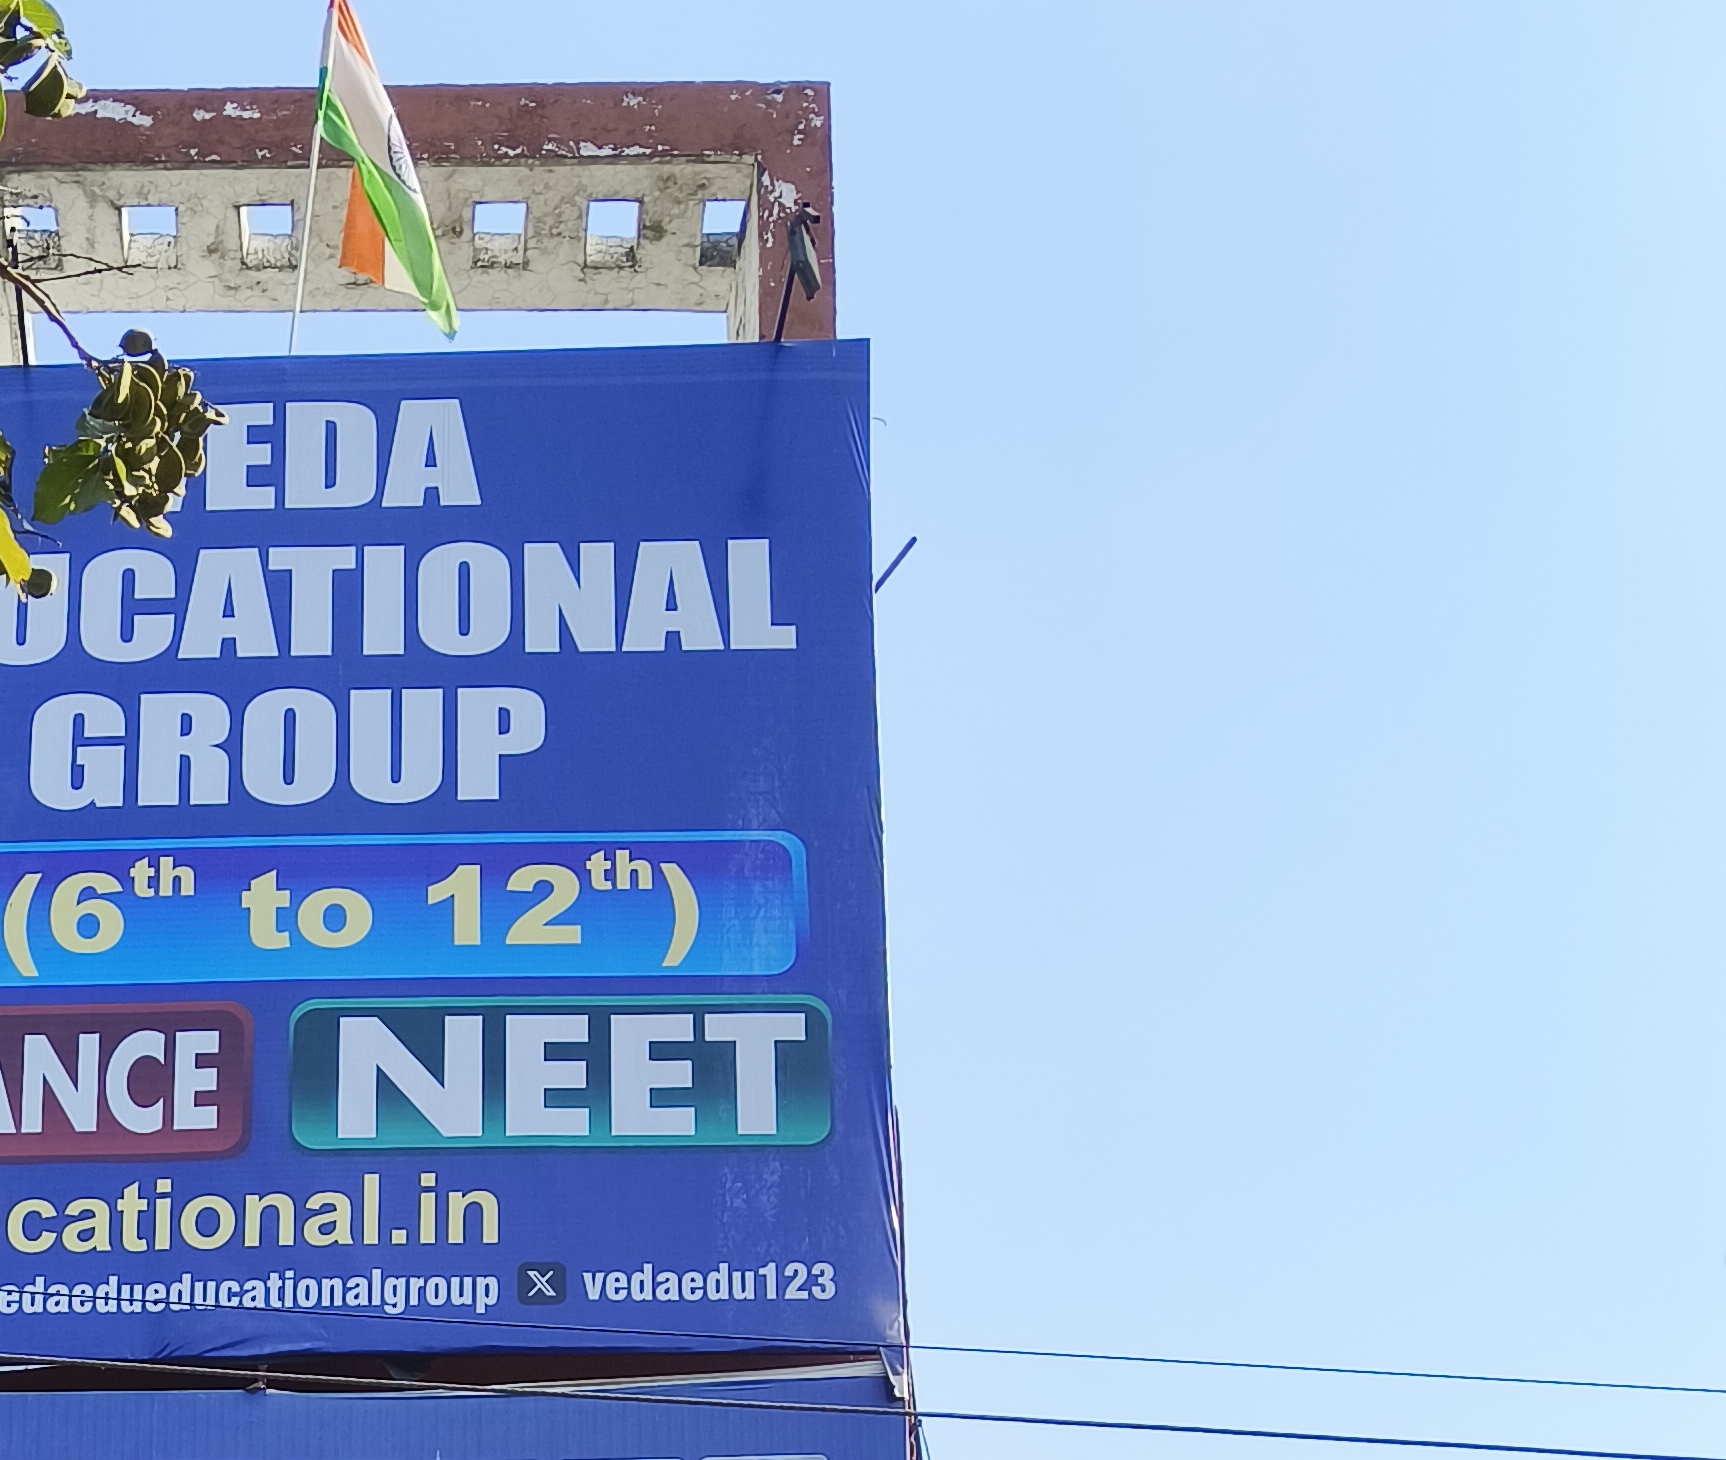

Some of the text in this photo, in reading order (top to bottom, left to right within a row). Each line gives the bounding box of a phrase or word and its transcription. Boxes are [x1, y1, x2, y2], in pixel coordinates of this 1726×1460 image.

[162, 398, 481, 514] EDA
[28, 686, 547, 811] GROUP
[2, 856, 196, 977] (6th
[241, 868, 374, 950] to
[426, 849, 700, 968] 12th)
[336, 1011, 808, 1140] NEET
[581, 1261, 838, 1302] vedaedu123
